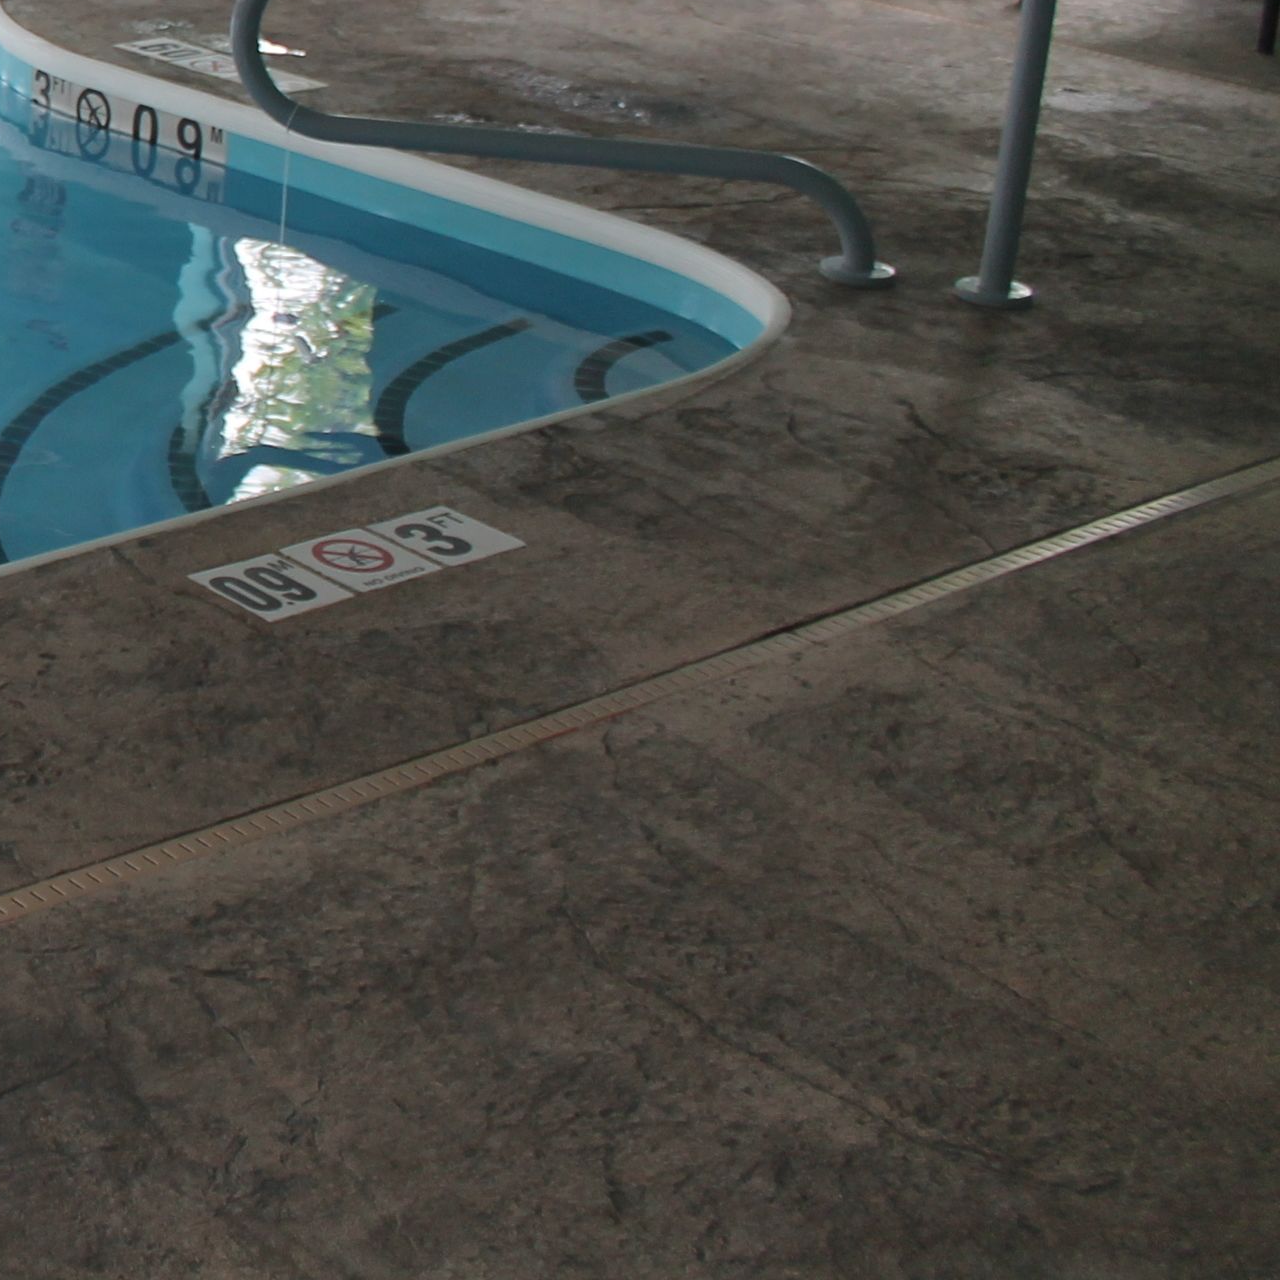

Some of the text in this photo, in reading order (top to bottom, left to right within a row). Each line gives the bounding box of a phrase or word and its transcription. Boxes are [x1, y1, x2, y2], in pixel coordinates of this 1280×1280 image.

[31, 70, 51, 110] 3
[210, 125, 223, 144] M
[427, 512, 464, 529] FT
[394, 522, 473, 557] 3
[267, 560, 295, 574] M
[363, 566, 426, 587] NO DIVING
